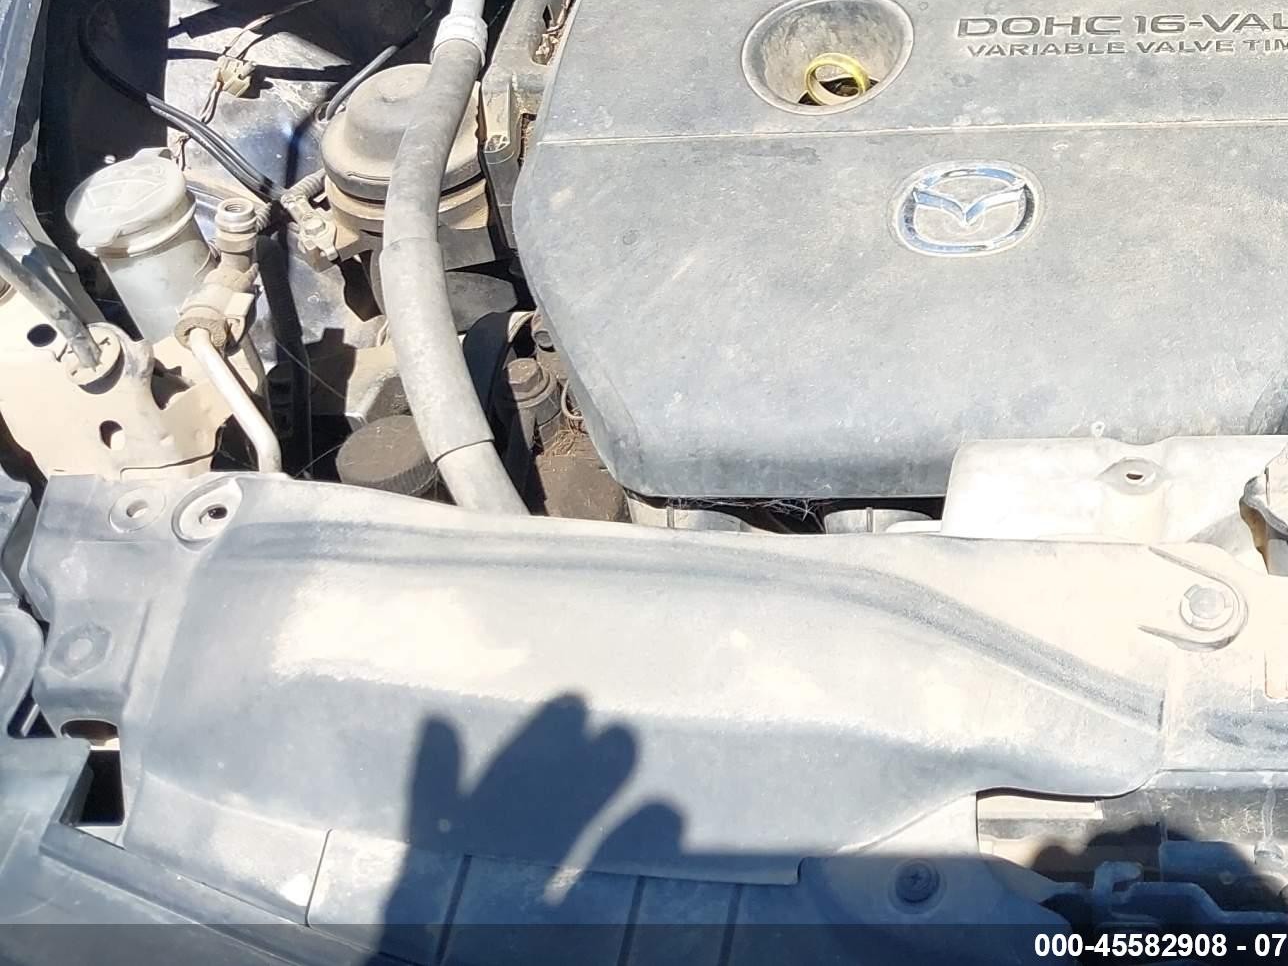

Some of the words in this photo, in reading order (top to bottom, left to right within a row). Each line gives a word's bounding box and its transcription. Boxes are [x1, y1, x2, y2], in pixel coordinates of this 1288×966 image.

[958, 15, 1122, 39] DOHC
[967, 41, 1126, 57] VARIABLE
[1137, 39, 1235, 54] VALVE
